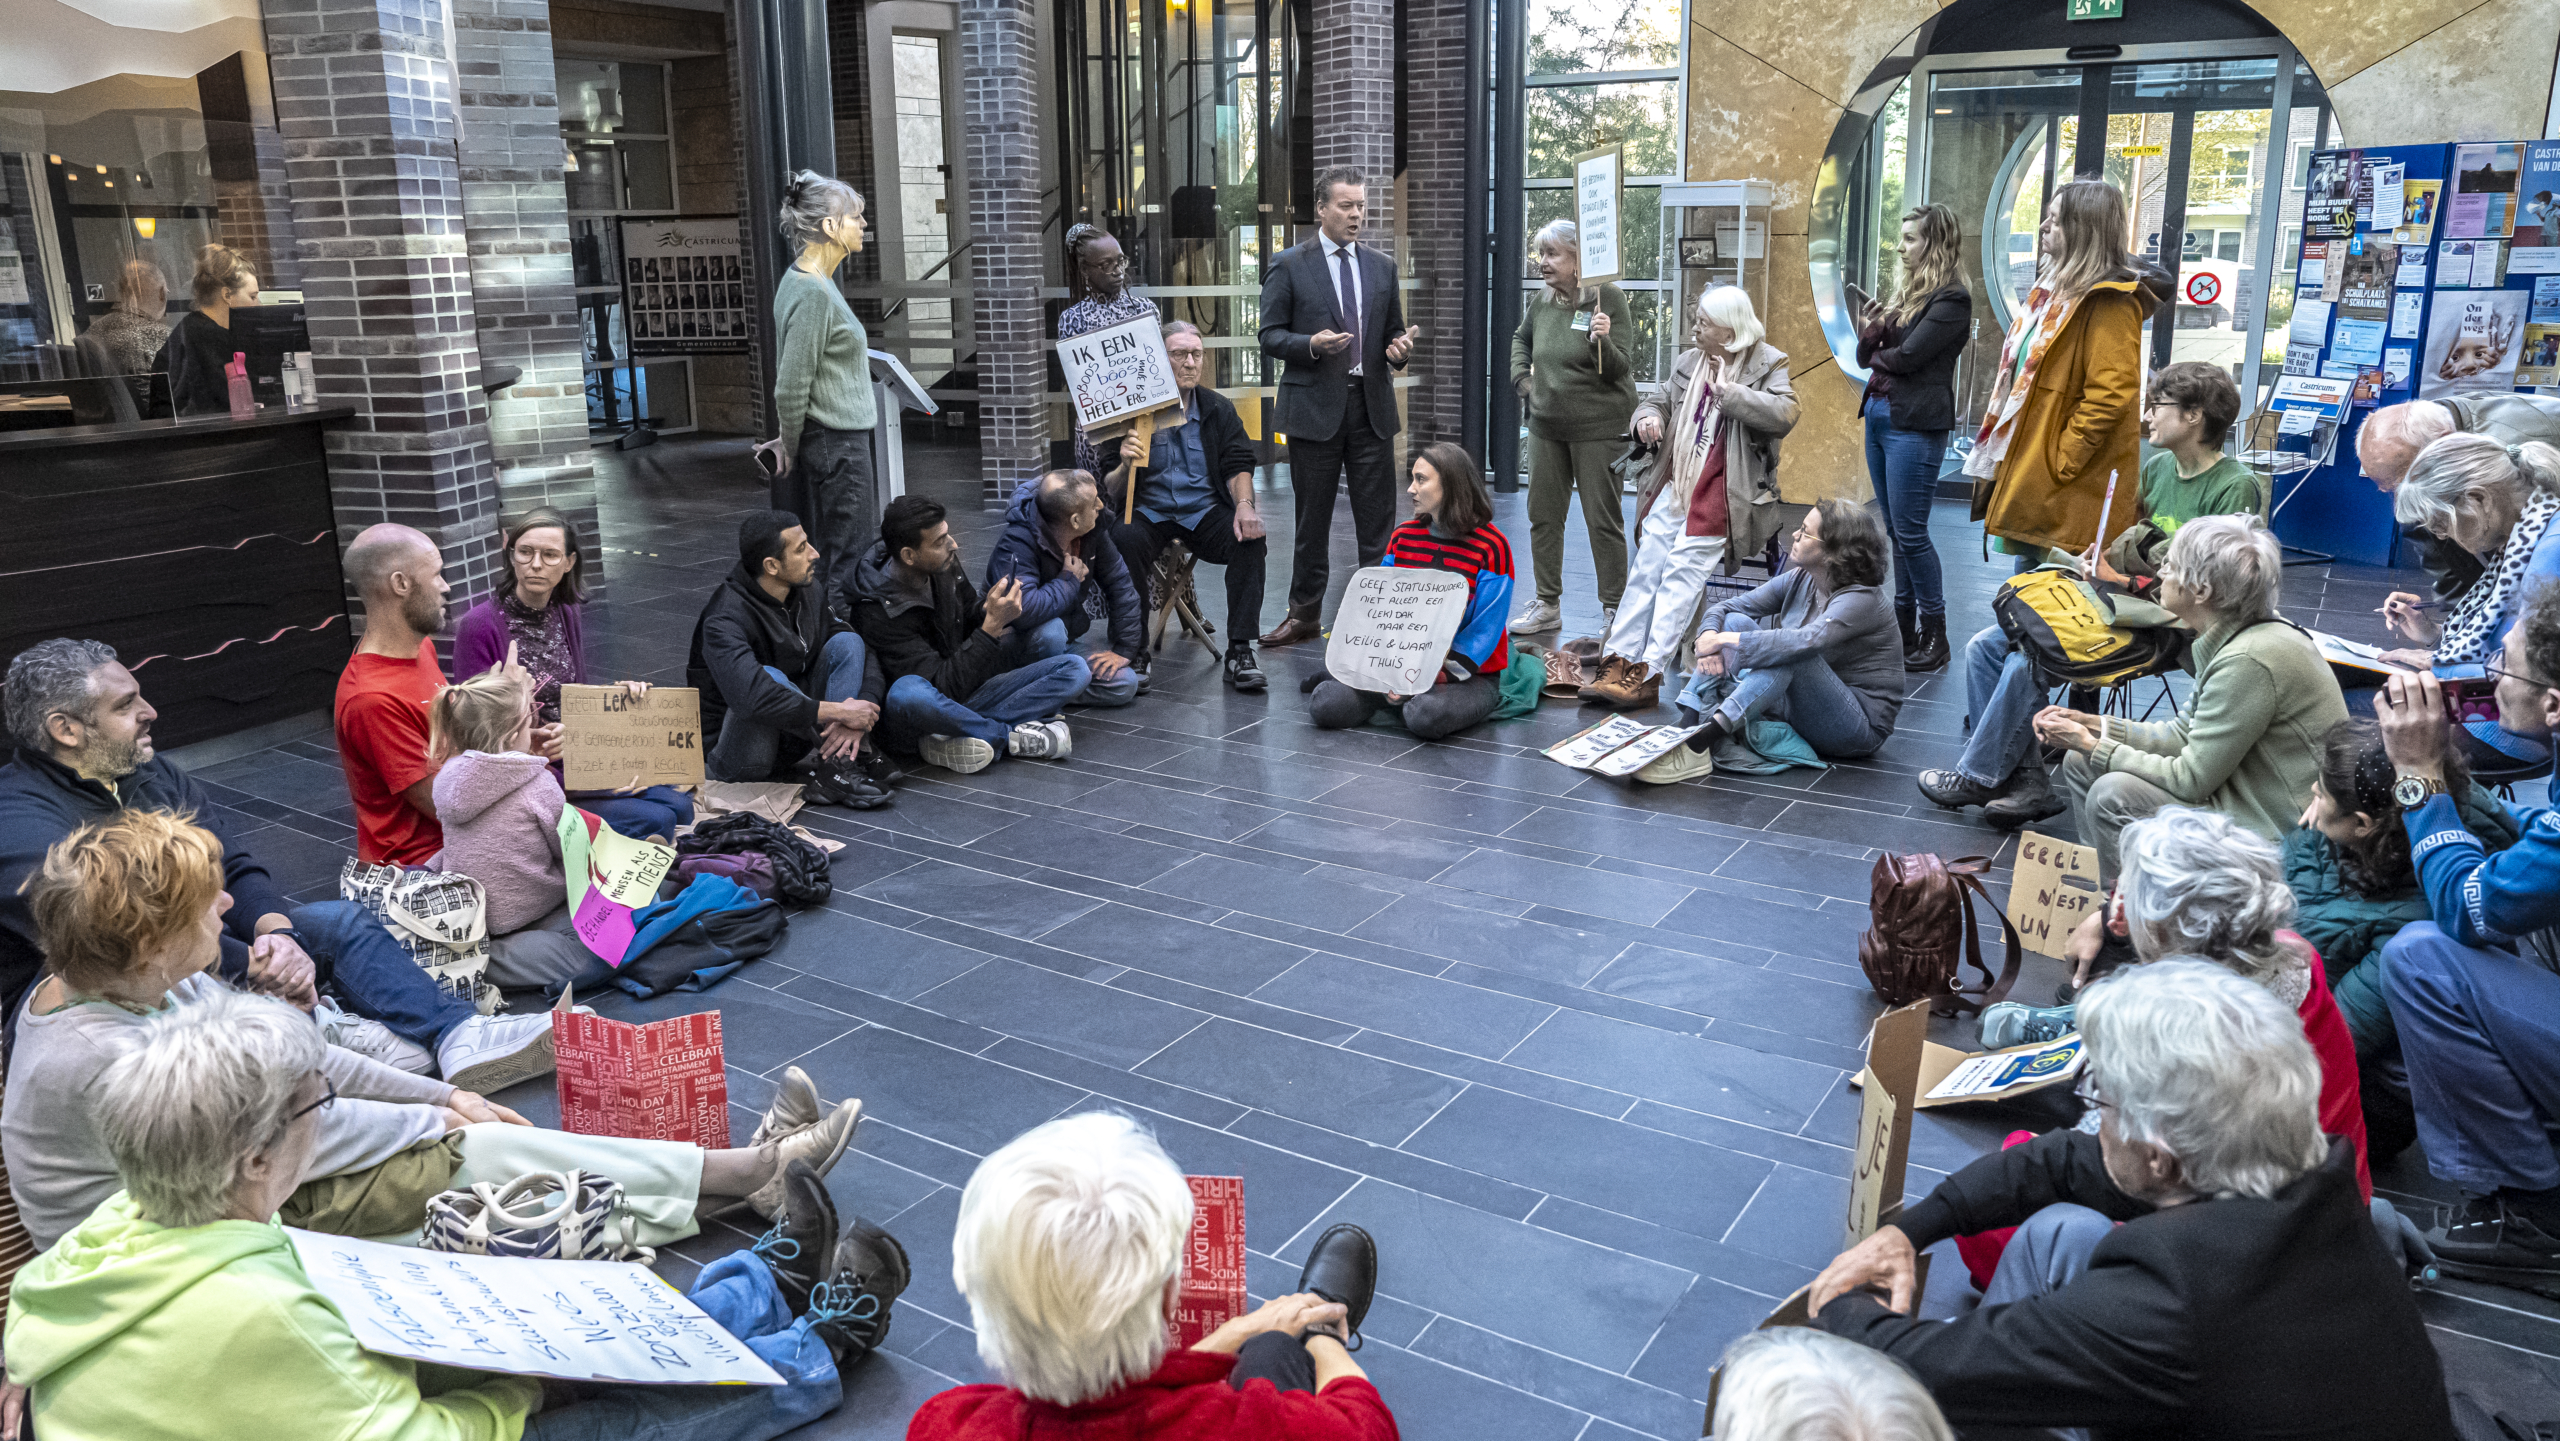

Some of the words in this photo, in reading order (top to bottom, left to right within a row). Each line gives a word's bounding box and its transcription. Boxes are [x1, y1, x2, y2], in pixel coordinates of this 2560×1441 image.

[2533, 161, 2550, 172] VAN
[2308, 206, 2331, 214] HEEFT
[2332, 206, 2344, 214] ME
[2328, 198, 2353, 206] BUURT
[2348, 298, 2387, 308] SCHATKAMER
[2466, 303, 2482, 313] On
[2464, 314, 2483, 322] der
[2463, 325, 2485, 334] weg
[1072, 346, 1096, 366] IK
[1101, 332, 1136, 358] BEN
[2286, 350, 2301, 358] DON'T
[2302, 352, 2315, 361] HOLD
[1108, 354, 1138, 368] boos
[2286, 357, 2295, 365] THE
[1078, 382, 1128, 408] BOOS
[2300, 382, 2336, 392] Castricums
[1084, 400, 1122, 422] HEEL
[1126, 392, 1146, 406] ERG
[1392, 581, 1465, 593] STATUSHOUDERS
[1368, 608, 1393, 619] (LEK)
[1395, 611, 1414, 619] DAK
[1386, 639, 1396, 649] &
[610, 870, 635, 899] MENSEN
[631, 850, 649, 866] ALS
[636, 845, 674, 887] MENS!
[2038, 888, 2089, 912] N'EST
[580, 905, 613, 942] BEHANDEL
[2020, 914, 2050, 940] UN
[561, 1012, 569, 1047] PRESENT
[684, 1015, 693, 1050] PRESENT
[555, 1046, 595, 1062] LEBRATE
[660, 1045, 724, 1066] CELEBRATE
[624, 1050, 634, 1078] XMAS
[642, 1058, 710, 1080] ENTERTAINMENT
[670, 1067, 711, 1080] TRADITIONS
[571, 1077, 598, 1088] MERRY
[662, 1076, 670, 1094] KIDS
[695, 1073, 726, 1086] MERRY
[621, 1095, 665, 1110] HOLIDAY
[671, 1087, 681, 1122] ORIGINAL
[666, 1105, 674, 1125] BELLS
[689, 1107, 698, 1137] FESTIVAL
[709, 1105, 720, 1134] GOOD
[667, 1122, 689, 1132] GOOD
[1194, 1207, 1209, 1272] HOLIDAY
[1227, 1244, 1235, 1268] SNOW
[1211, 1269, 1238, 1279] KIDS
[401, 1261, 506, 1356] behandeling
[445, 1259, 571, 1362] Statushouders
[468, 1306, 496, 1325] van
[544, 1291, 617, 1344] Wees
[640, 1311, 679, 1338] voor
